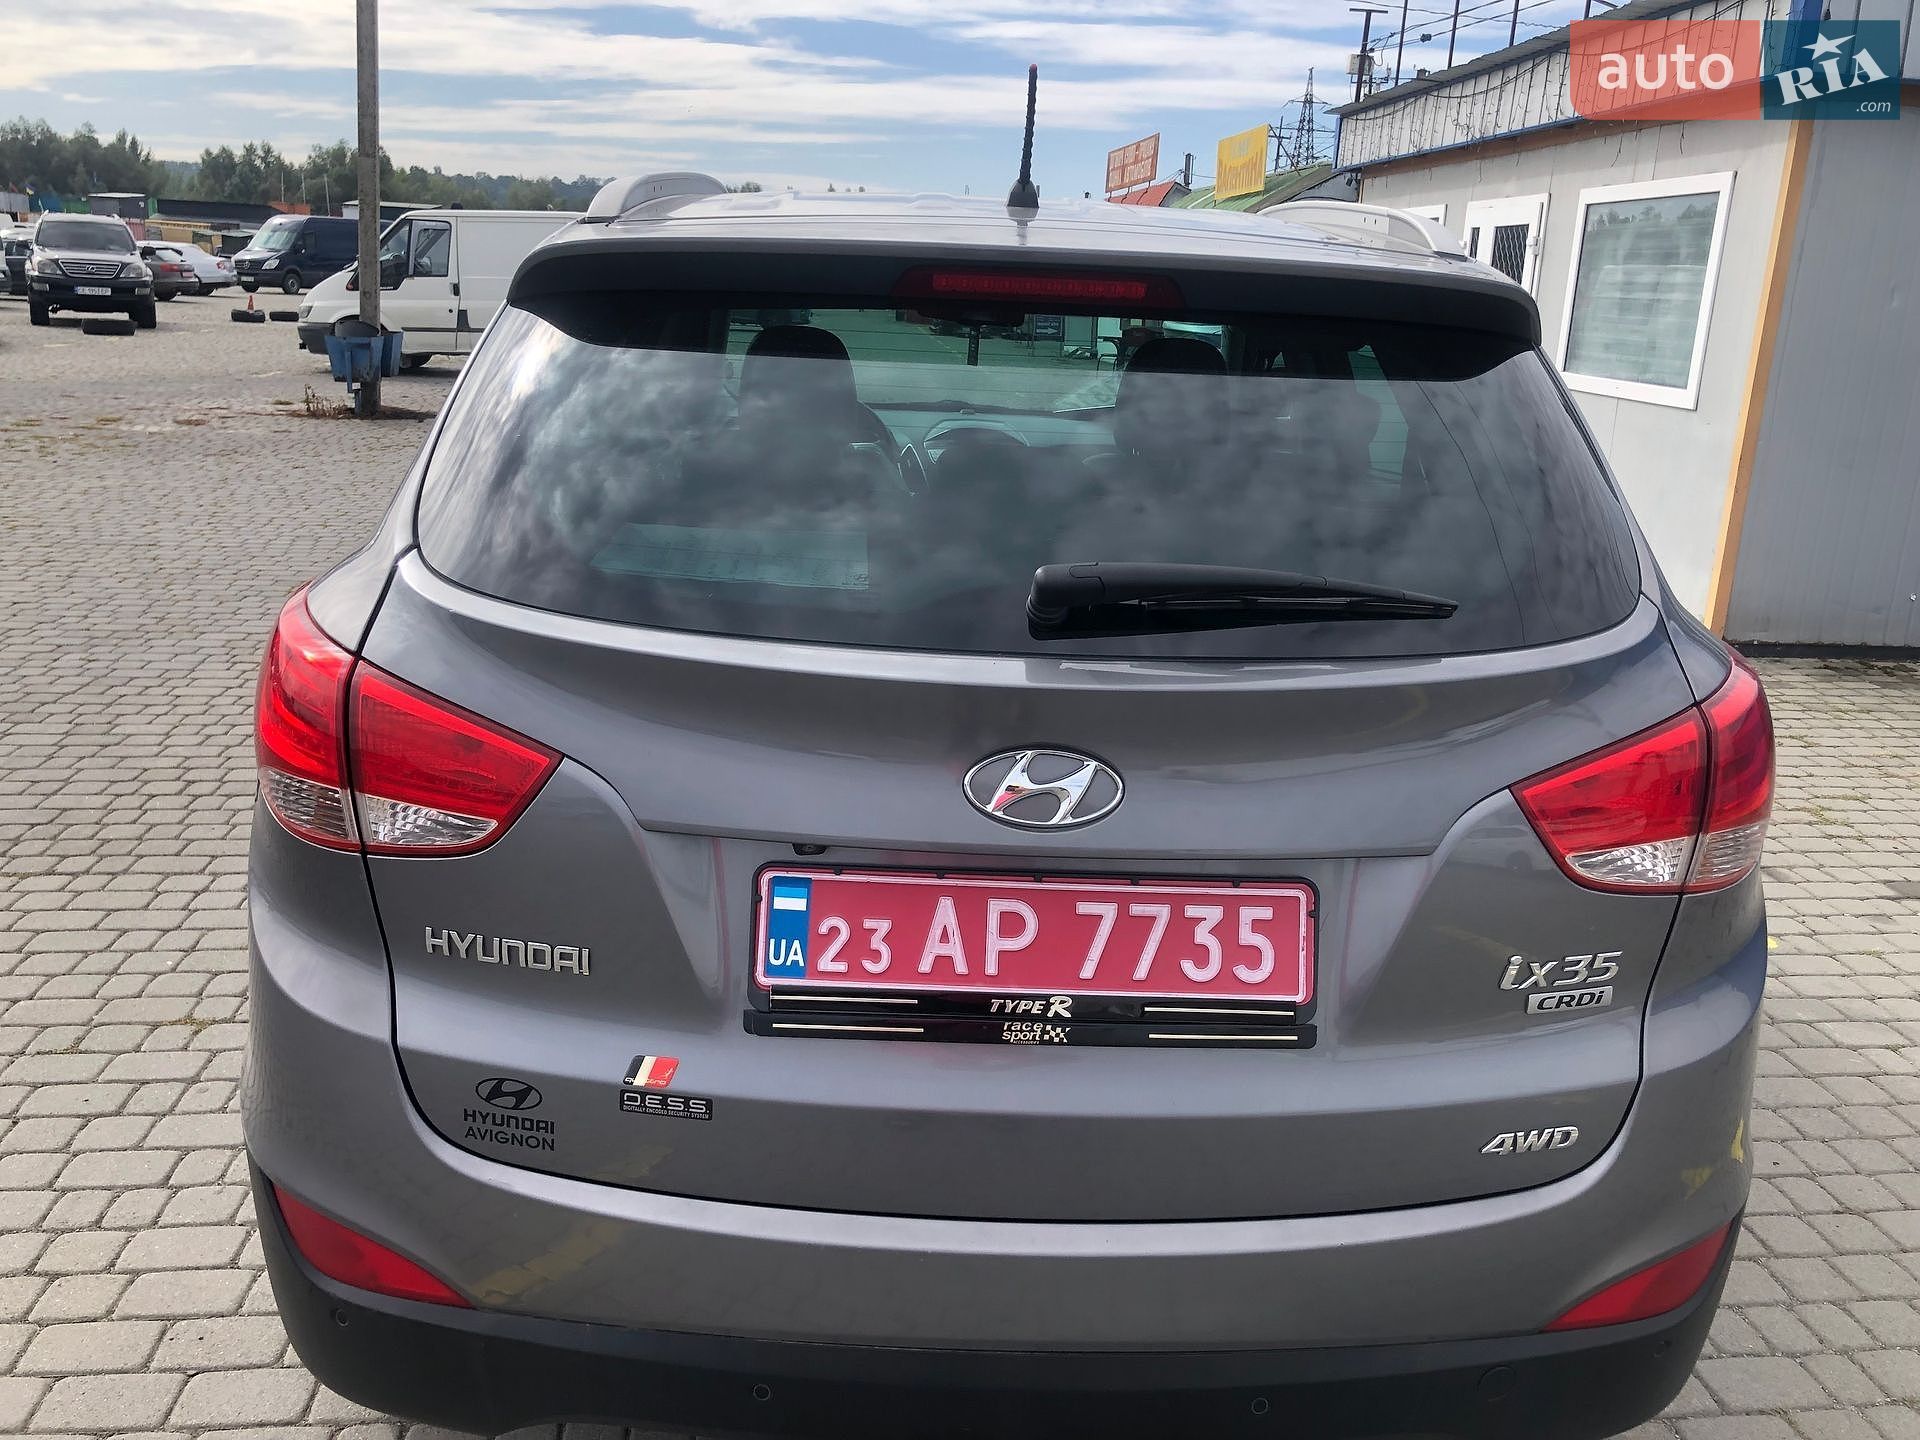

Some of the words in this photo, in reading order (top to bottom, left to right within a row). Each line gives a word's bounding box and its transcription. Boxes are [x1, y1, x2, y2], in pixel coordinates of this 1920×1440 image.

[424, 926, 591, 977] HYUNDAI
[768, 938, 805, 968] UA
[815, 915, 894, 975] 23
[917, 896, 1039, 977] AP
[1075, 901, 1276, 985] 7735
[1498, 950, 1624, 991] ix35
[990, 998, 1047, 1014] TYPE
[1046, 995, 1073, 1018] R
[1536, 990, 1605, 1011] CRDi
[1001, 1030, 1042, 1043] sport
[1003, 1021, 1044, 1031] race
[463, 1108, 556, 1135] HYUNDAI
[464, 1127, 556, 1151] AVIGNON
[1480, 1126, 1580, 1155] 4WD
